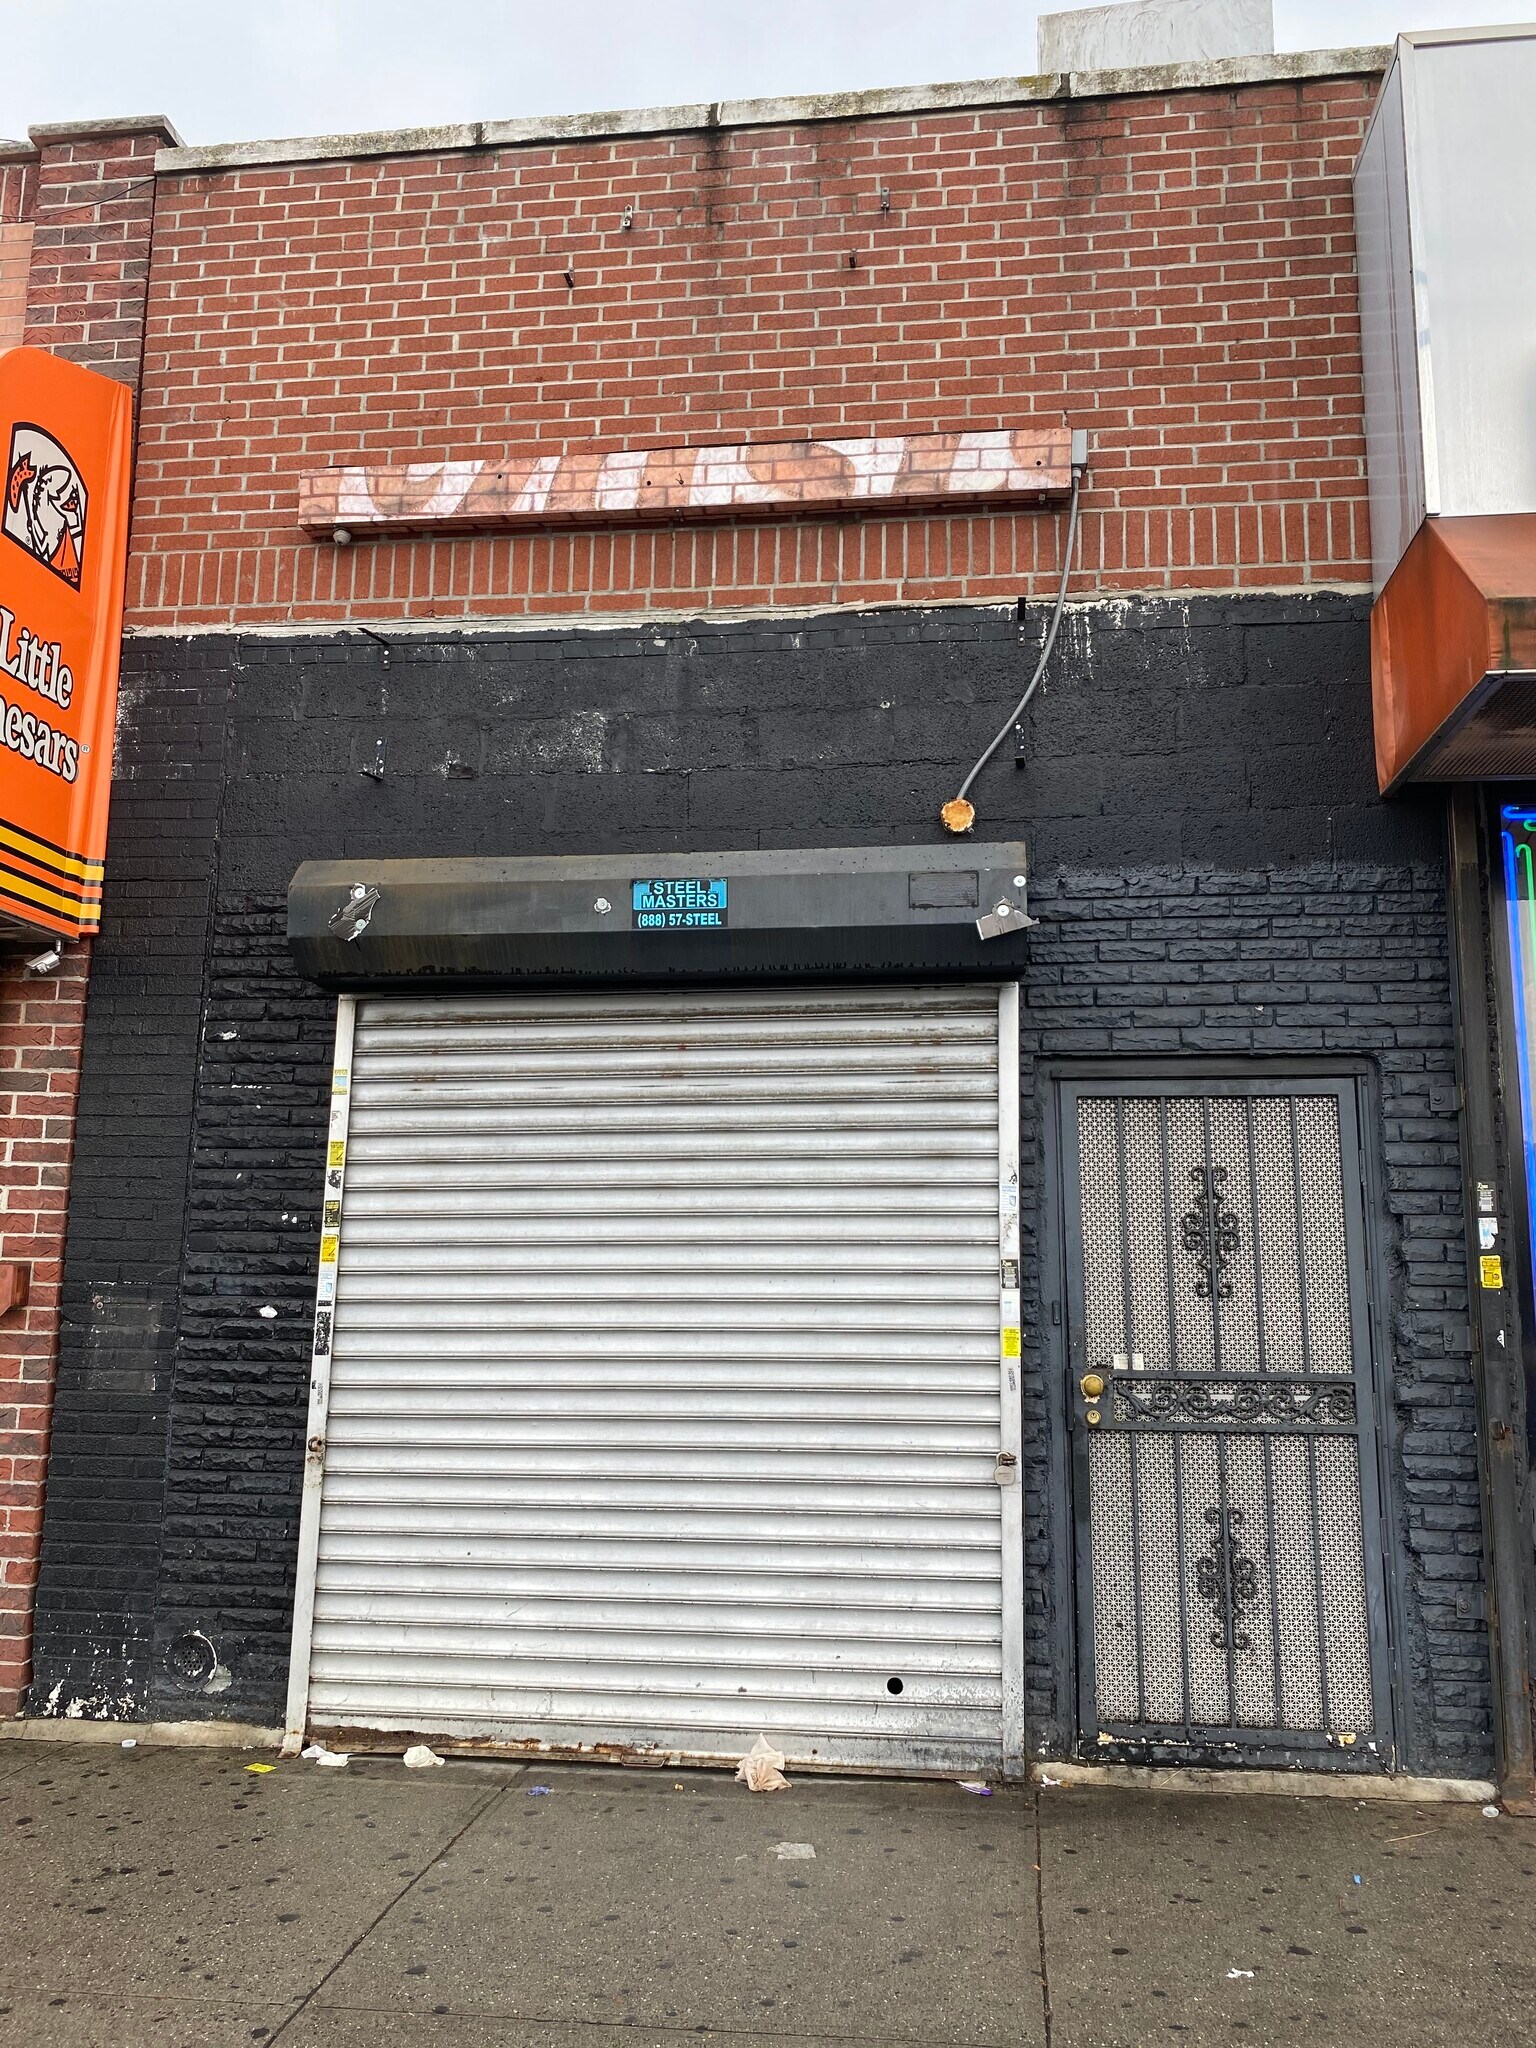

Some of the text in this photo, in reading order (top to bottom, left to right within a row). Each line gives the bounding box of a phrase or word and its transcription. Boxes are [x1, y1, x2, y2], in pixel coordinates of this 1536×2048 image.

[0, 605, 73, 710] Little
[0, 696, 78, 783] esars
[653, 881, 706, 894] STEEL
[642, 894, 718, 908] MASTERS
[637, 912, 722, 928] (888) 57-STEEL
